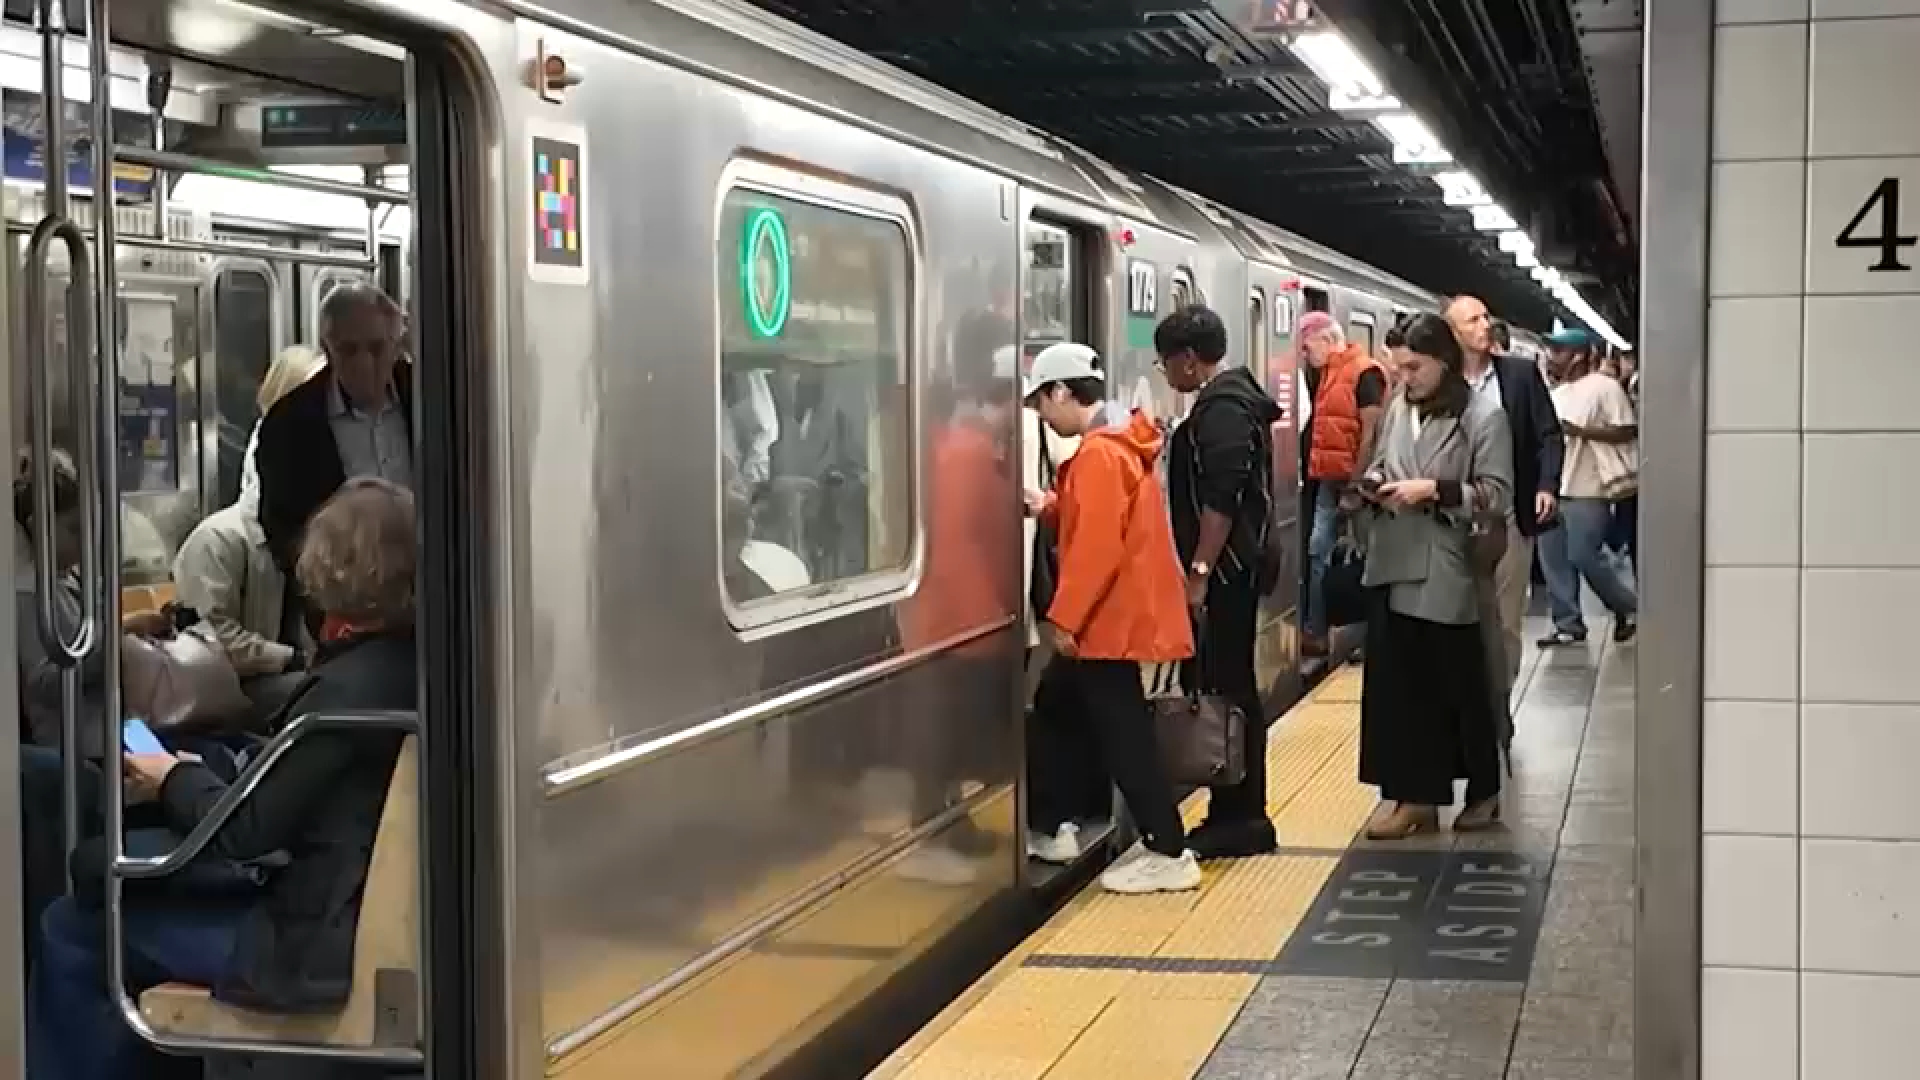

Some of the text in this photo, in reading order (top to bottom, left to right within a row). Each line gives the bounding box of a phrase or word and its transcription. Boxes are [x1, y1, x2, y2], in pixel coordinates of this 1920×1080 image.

[1836, 178, 1918, 271] 4
[1312, 871, 1418, 946] STEP
[1429, 863, 1531, 963] ASIDE
